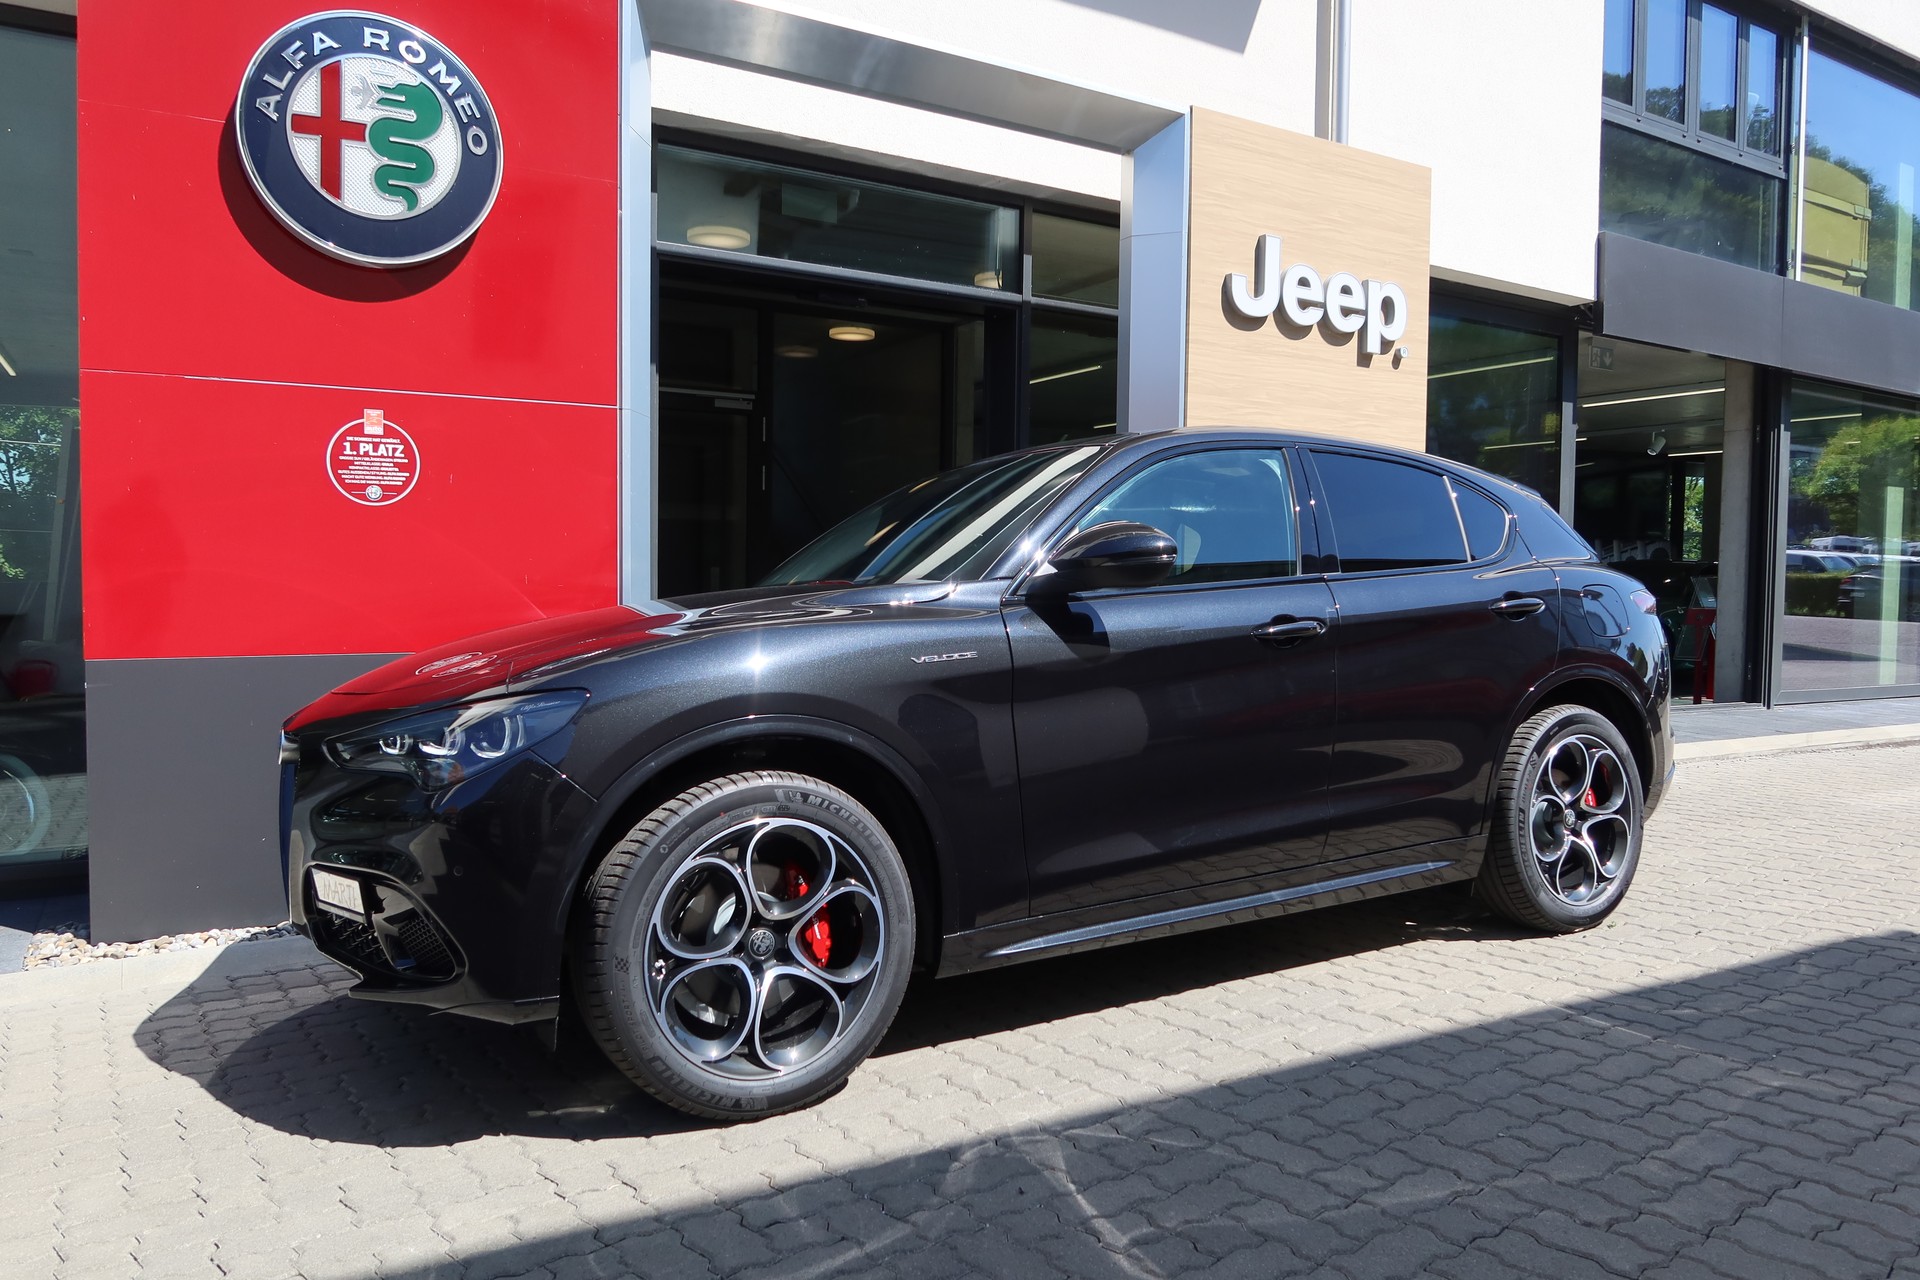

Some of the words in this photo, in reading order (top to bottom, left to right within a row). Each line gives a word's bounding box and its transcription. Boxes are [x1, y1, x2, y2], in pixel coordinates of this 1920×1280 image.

[256, 31, 341, 121] ALFA
[363, 26, 488, 155] ROMEO
[1222, 234, 1407, 355] Jeep
[343, 442, 357, 455] 1.
[359, 443, 405, 457] PLATZ
[911, 651, 978, 664] VELOCE
[807, 795, 881, 850] MICHELIN
